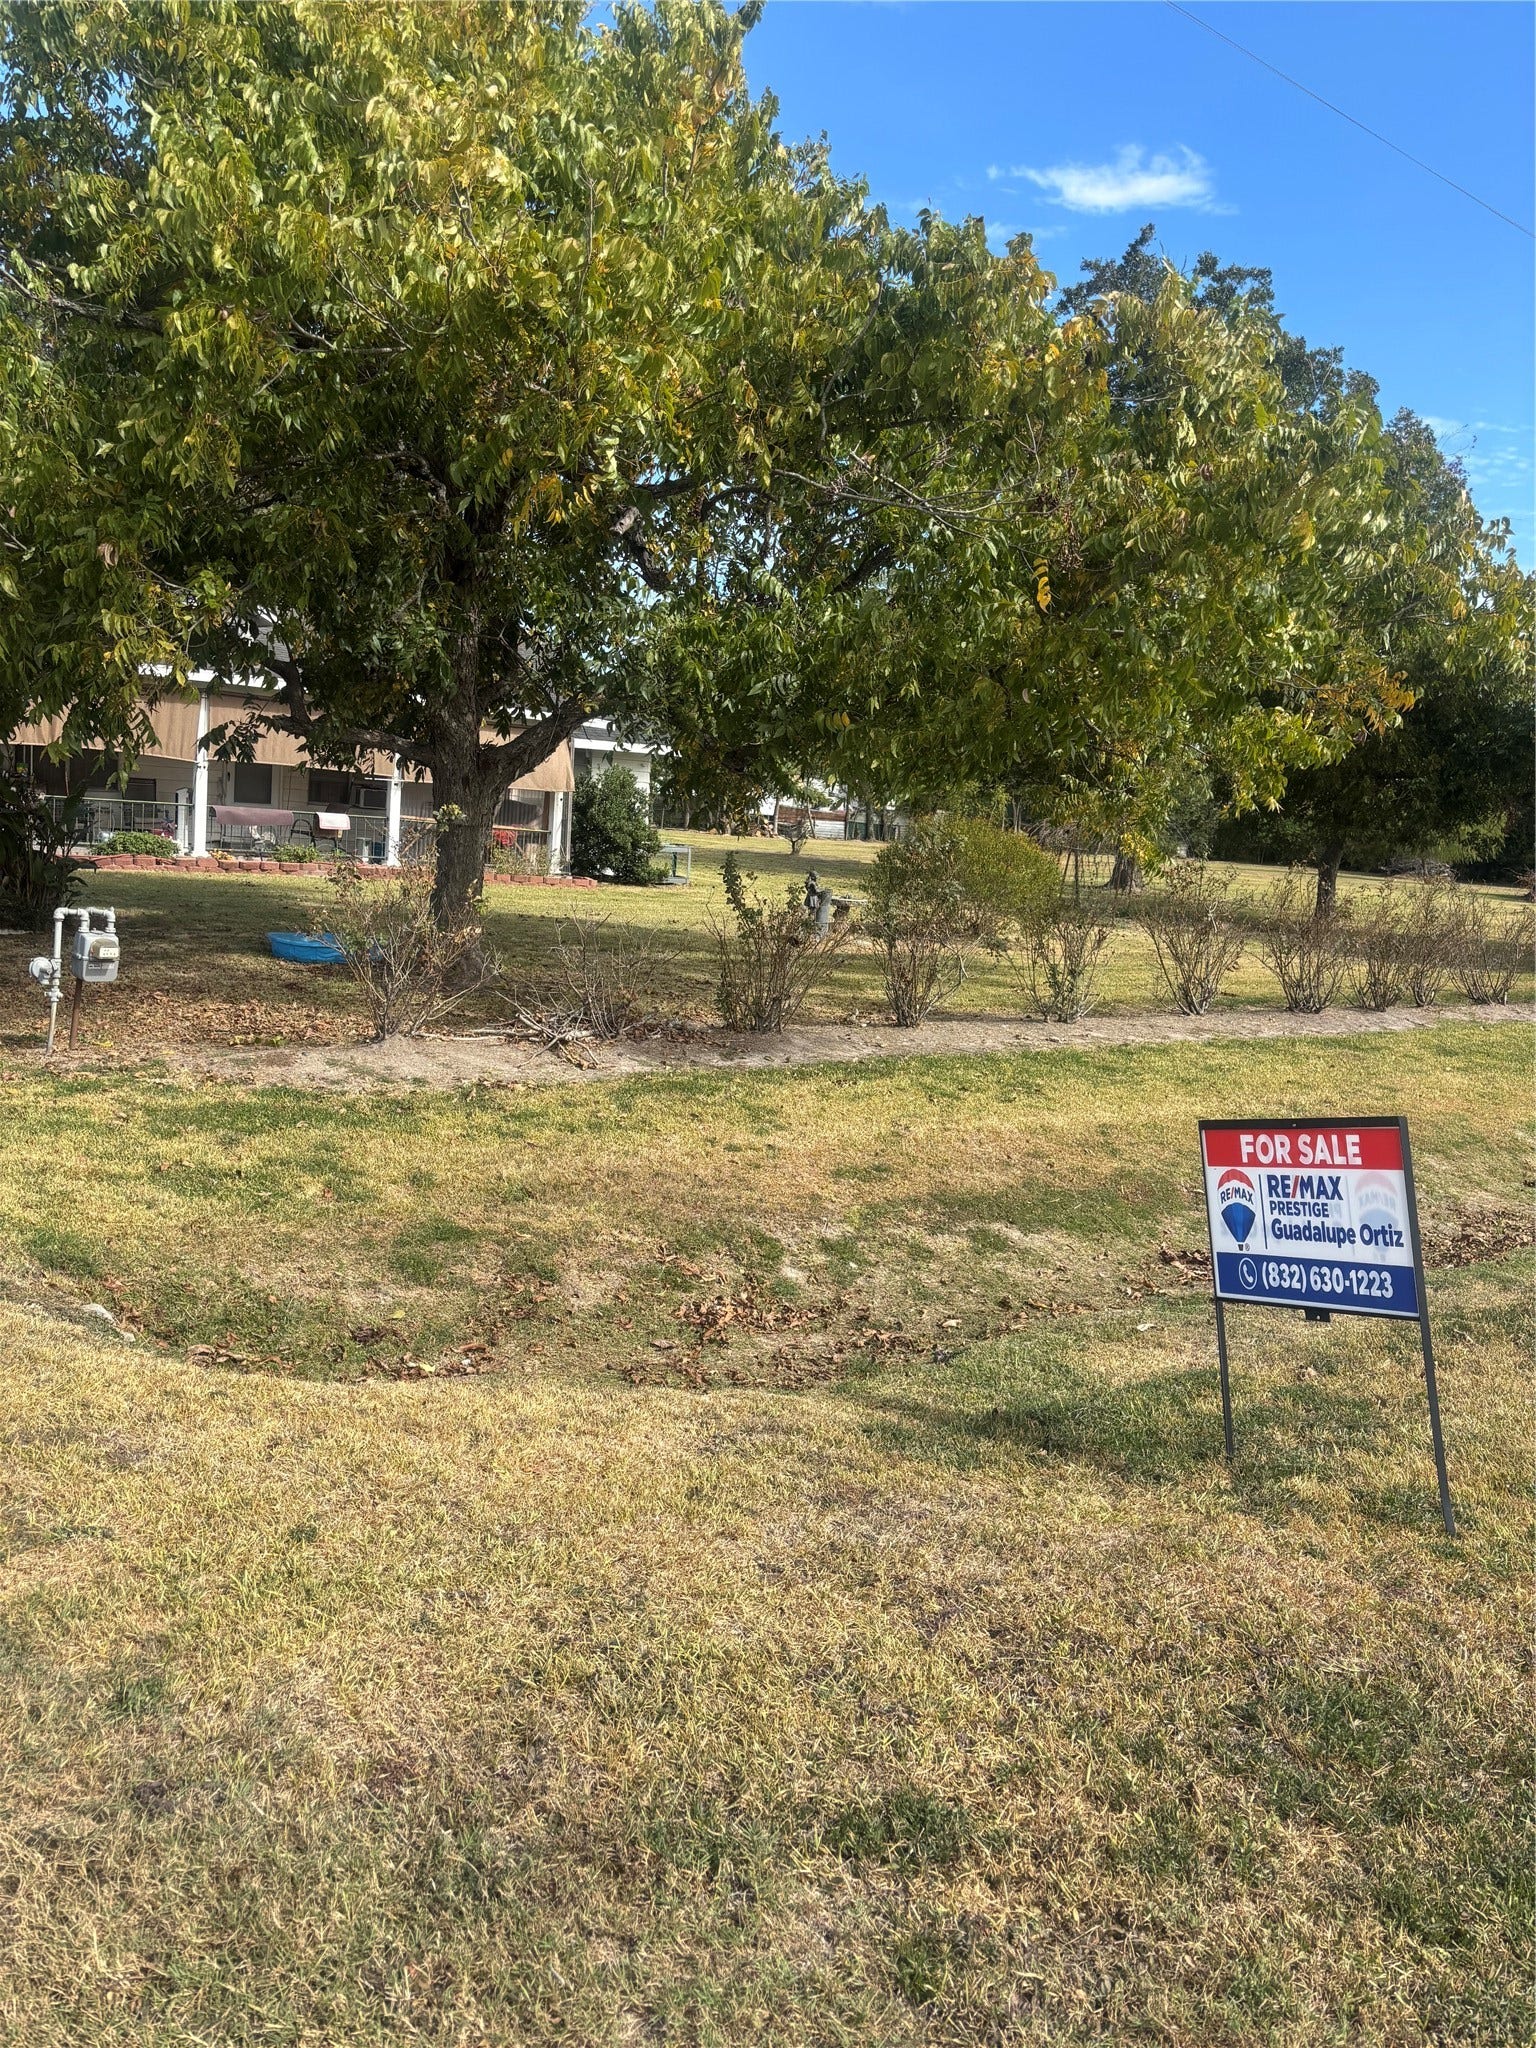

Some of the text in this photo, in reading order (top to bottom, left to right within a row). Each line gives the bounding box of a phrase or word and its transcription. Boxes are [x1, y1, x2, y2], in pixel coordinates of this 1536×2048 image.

[1240, 1134, 1362, 1165] FOR SALE
[1220, 1186, 1254, 1205] RE/MAX
[1267, 1174, 1344, 1200] RE/MAX
[1270, 1200, 1329, 1218] PRESTIGE
[1271, 1218, 1404, 1248] Guadalupe Ortiz
[1262, 1261, 1394, 1298] (832) 630-1223
